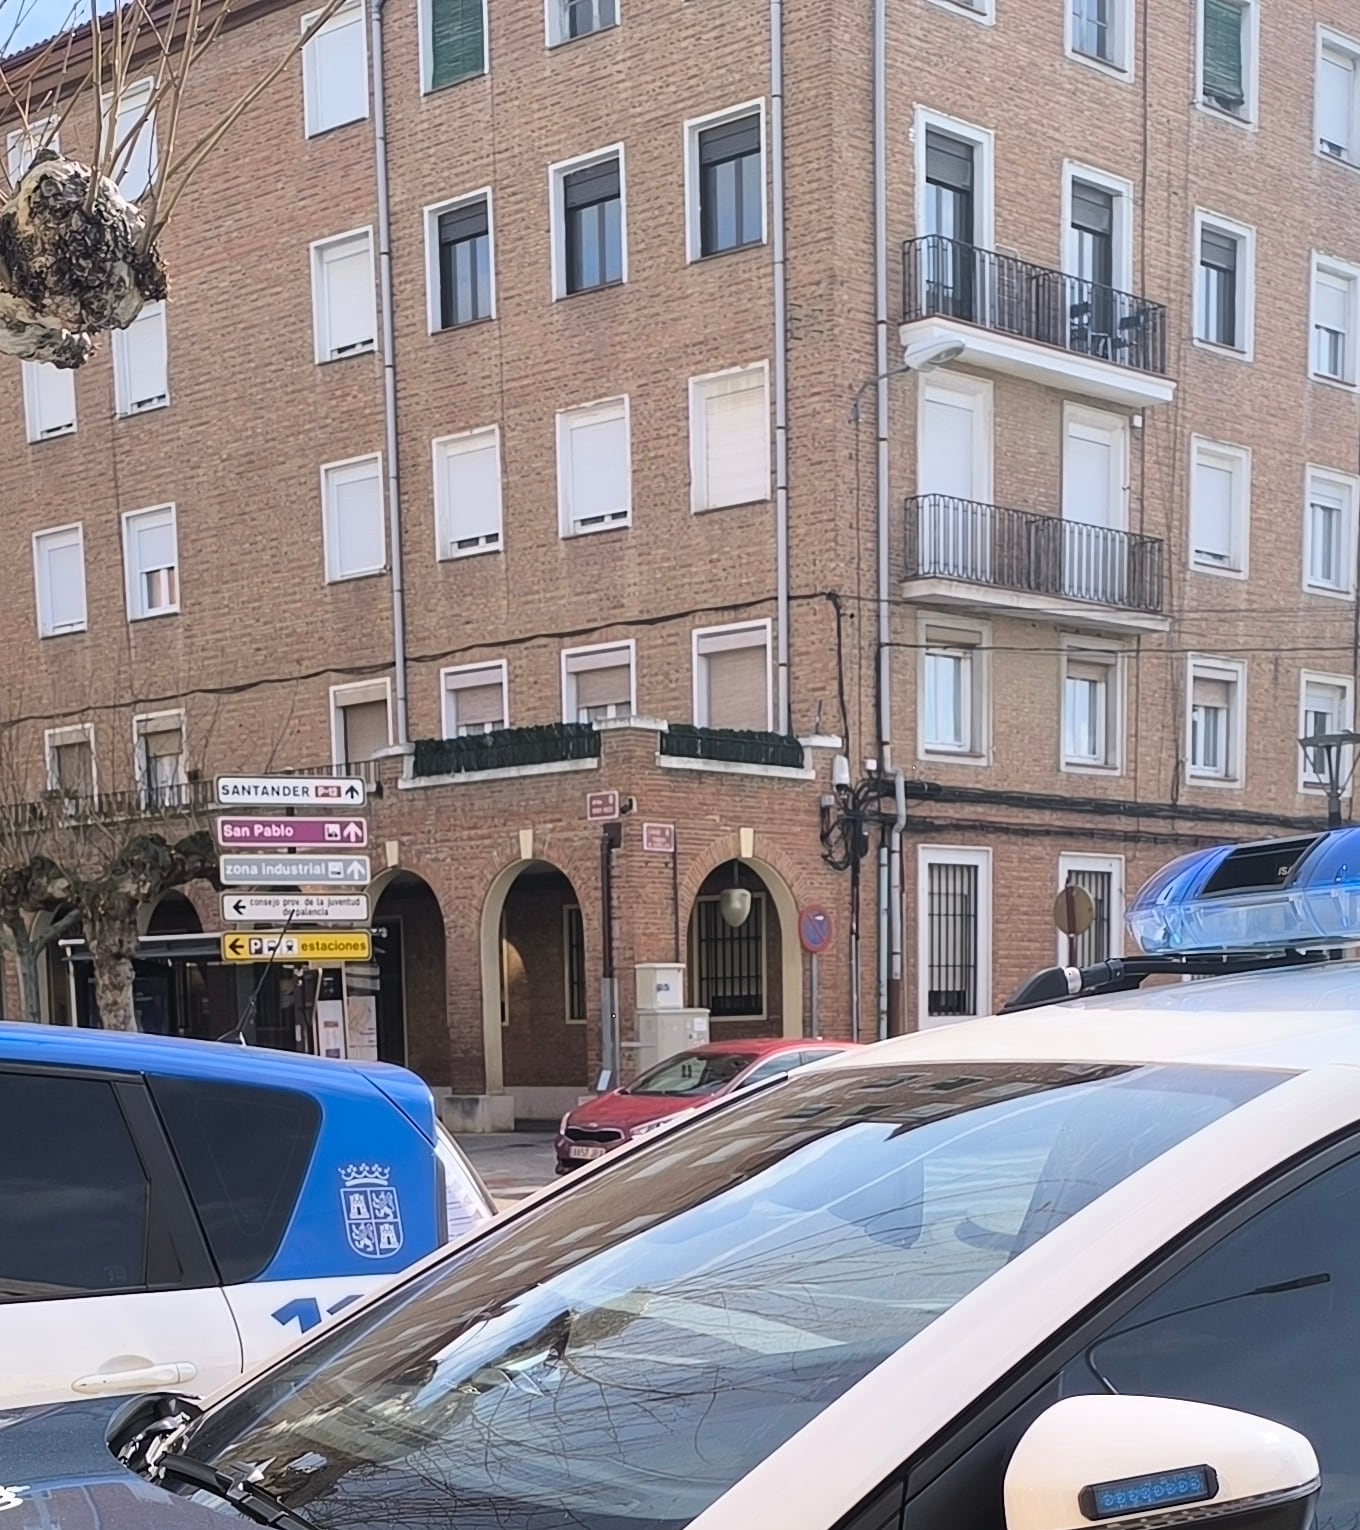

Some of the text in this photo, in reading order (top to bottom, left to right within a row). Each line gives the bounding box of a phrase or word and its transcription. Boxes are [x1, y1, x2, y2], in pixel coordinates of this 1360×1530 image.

[221, 784, 310, 797] SANTANDER
[223, 823, 294, 837] San Pablo
[225, 862, 325, 875] zona industrial
[249, 897, 280, 907] consejo
[304, 898, 314, 906] de
[317, 898, 324, 906] la
[328, 898, 360, 908] juventud
[296, 908, 329, 917] palencia
[301, 940, 367, 952] estaciones
